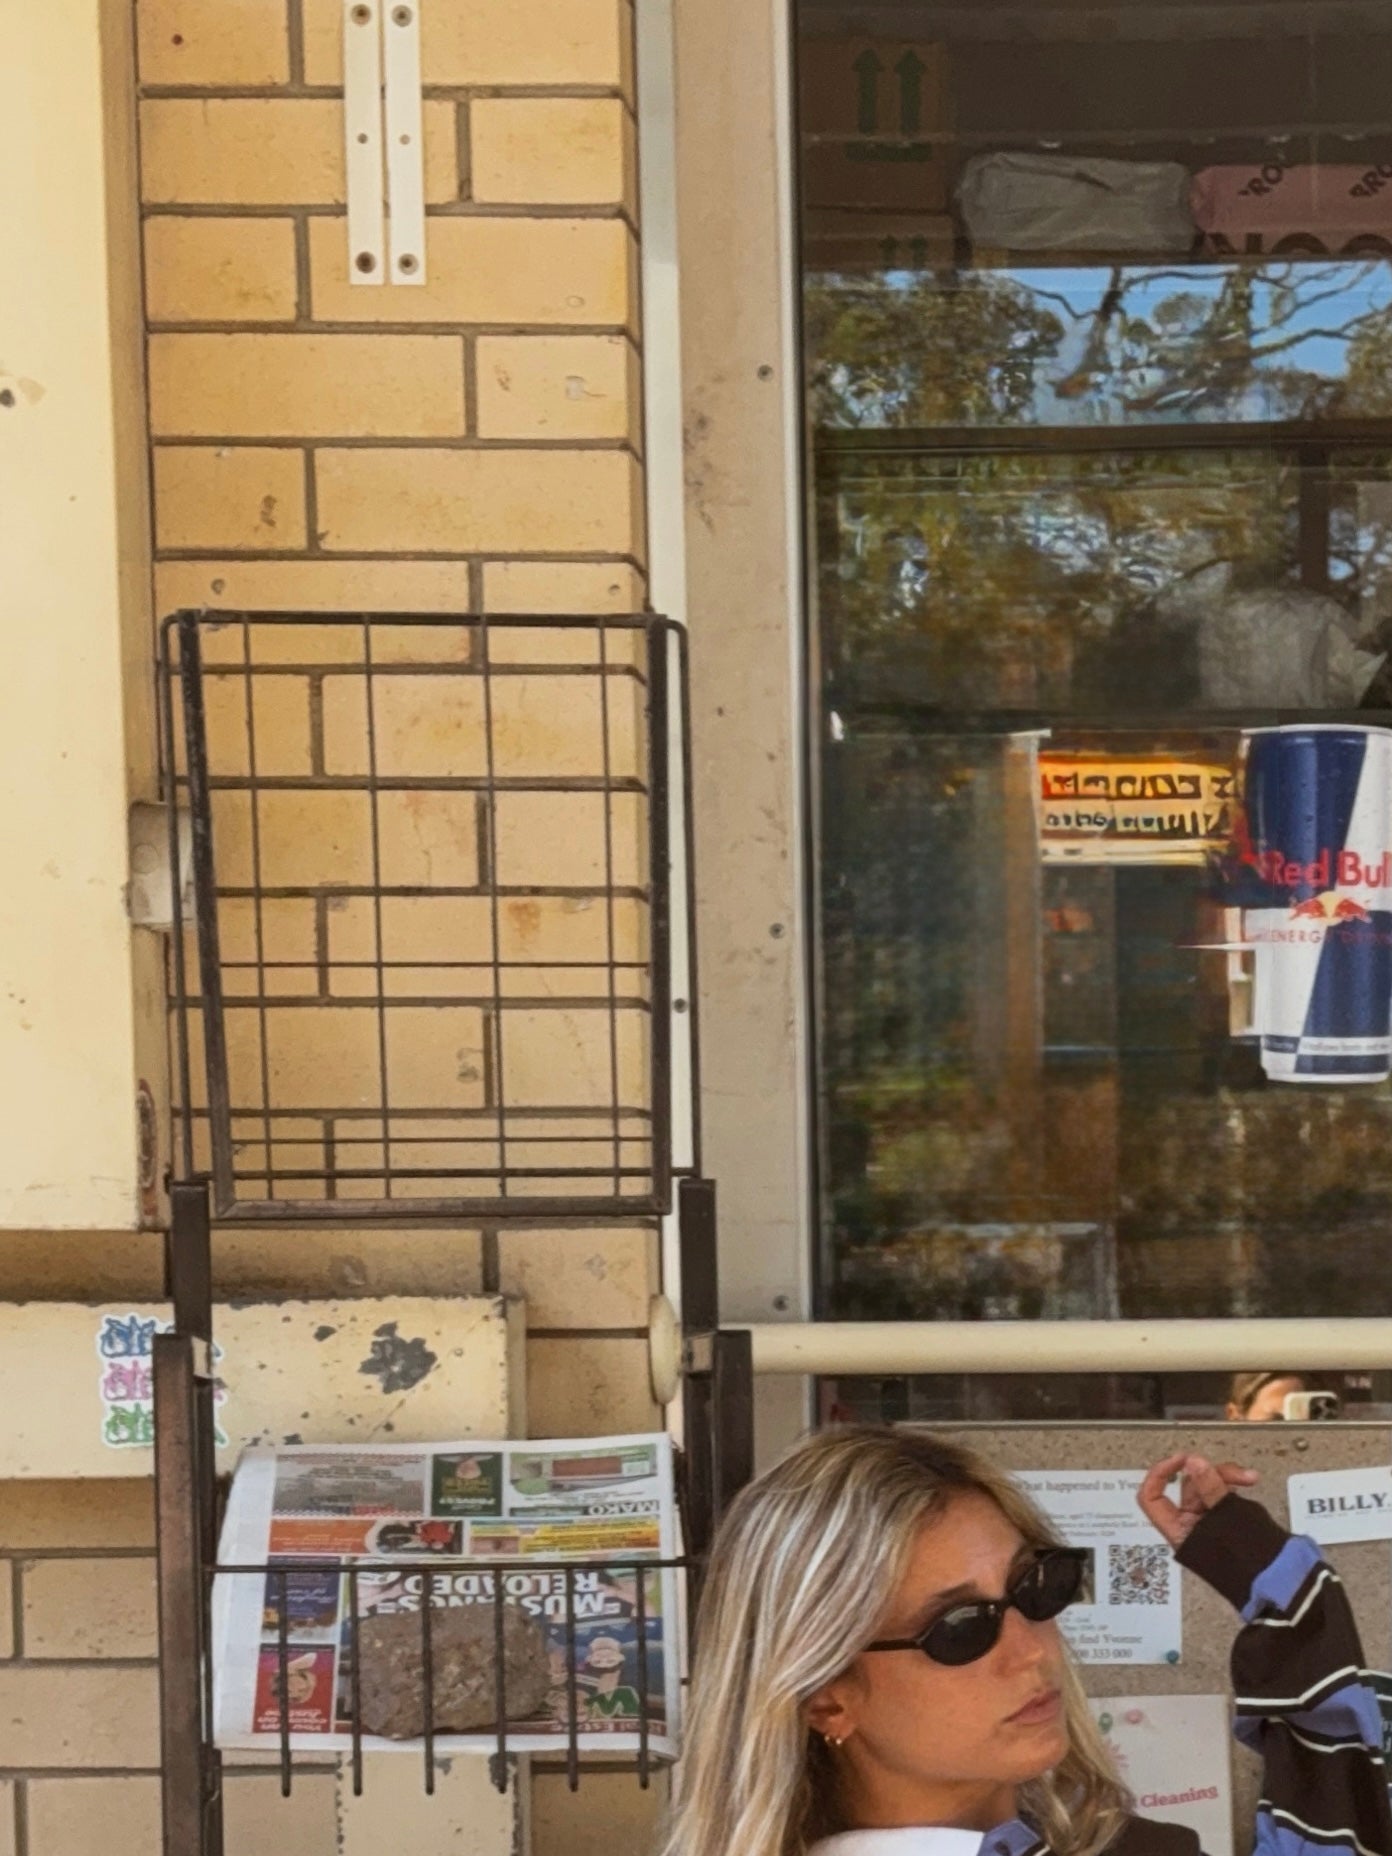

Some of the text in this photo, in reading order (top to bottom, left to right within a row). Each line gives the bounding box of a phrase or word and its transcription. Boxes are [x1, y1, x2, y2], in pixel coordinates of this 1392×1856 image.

[1264, 848, 1330, 886] Red
[1046, 1479, 1098, 1493] happened
[1140, 1785, 1219, 1808] Cleaning
